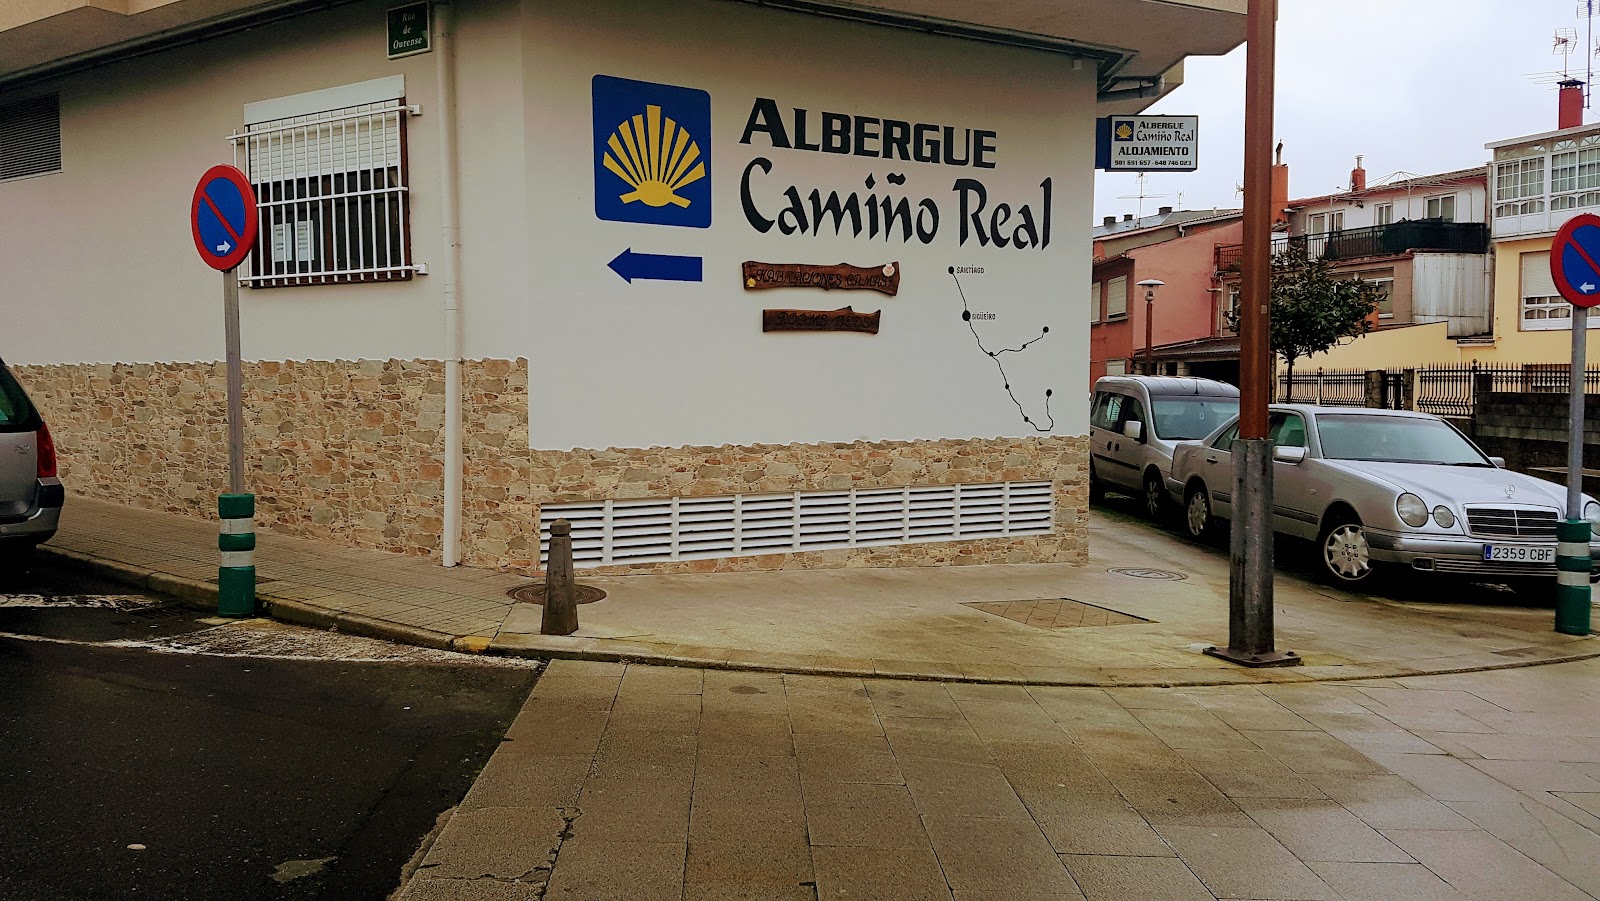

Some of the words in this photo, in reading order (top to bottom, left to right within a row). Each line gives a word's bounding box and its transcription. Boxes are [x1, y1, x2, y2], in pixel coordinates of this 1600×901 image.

[403, 25, 411, 34] de
[393, 37, 422, 49] Ourense
[1139, 121, 1184, 129] ALBERGUE
[739, 97, 997, 169] ALBERGUE
[1137, 131, 1171, 141] Camiño
[1174, 130, 1193, 141] Real
[1118, 146, 1189, 156] ALOJAMIENTO
[740, 157, 940, 245] Camiño
[952, 177, 1052, 251] Real
[847, 274, 887, 287] CAMAS
[776, 312, 828, 326] ROOMS
[836, 316, 870, 328] BEDS
[1494, 548, 1525, 559] 2359
[1530, 549, 1552, 560] CBF
